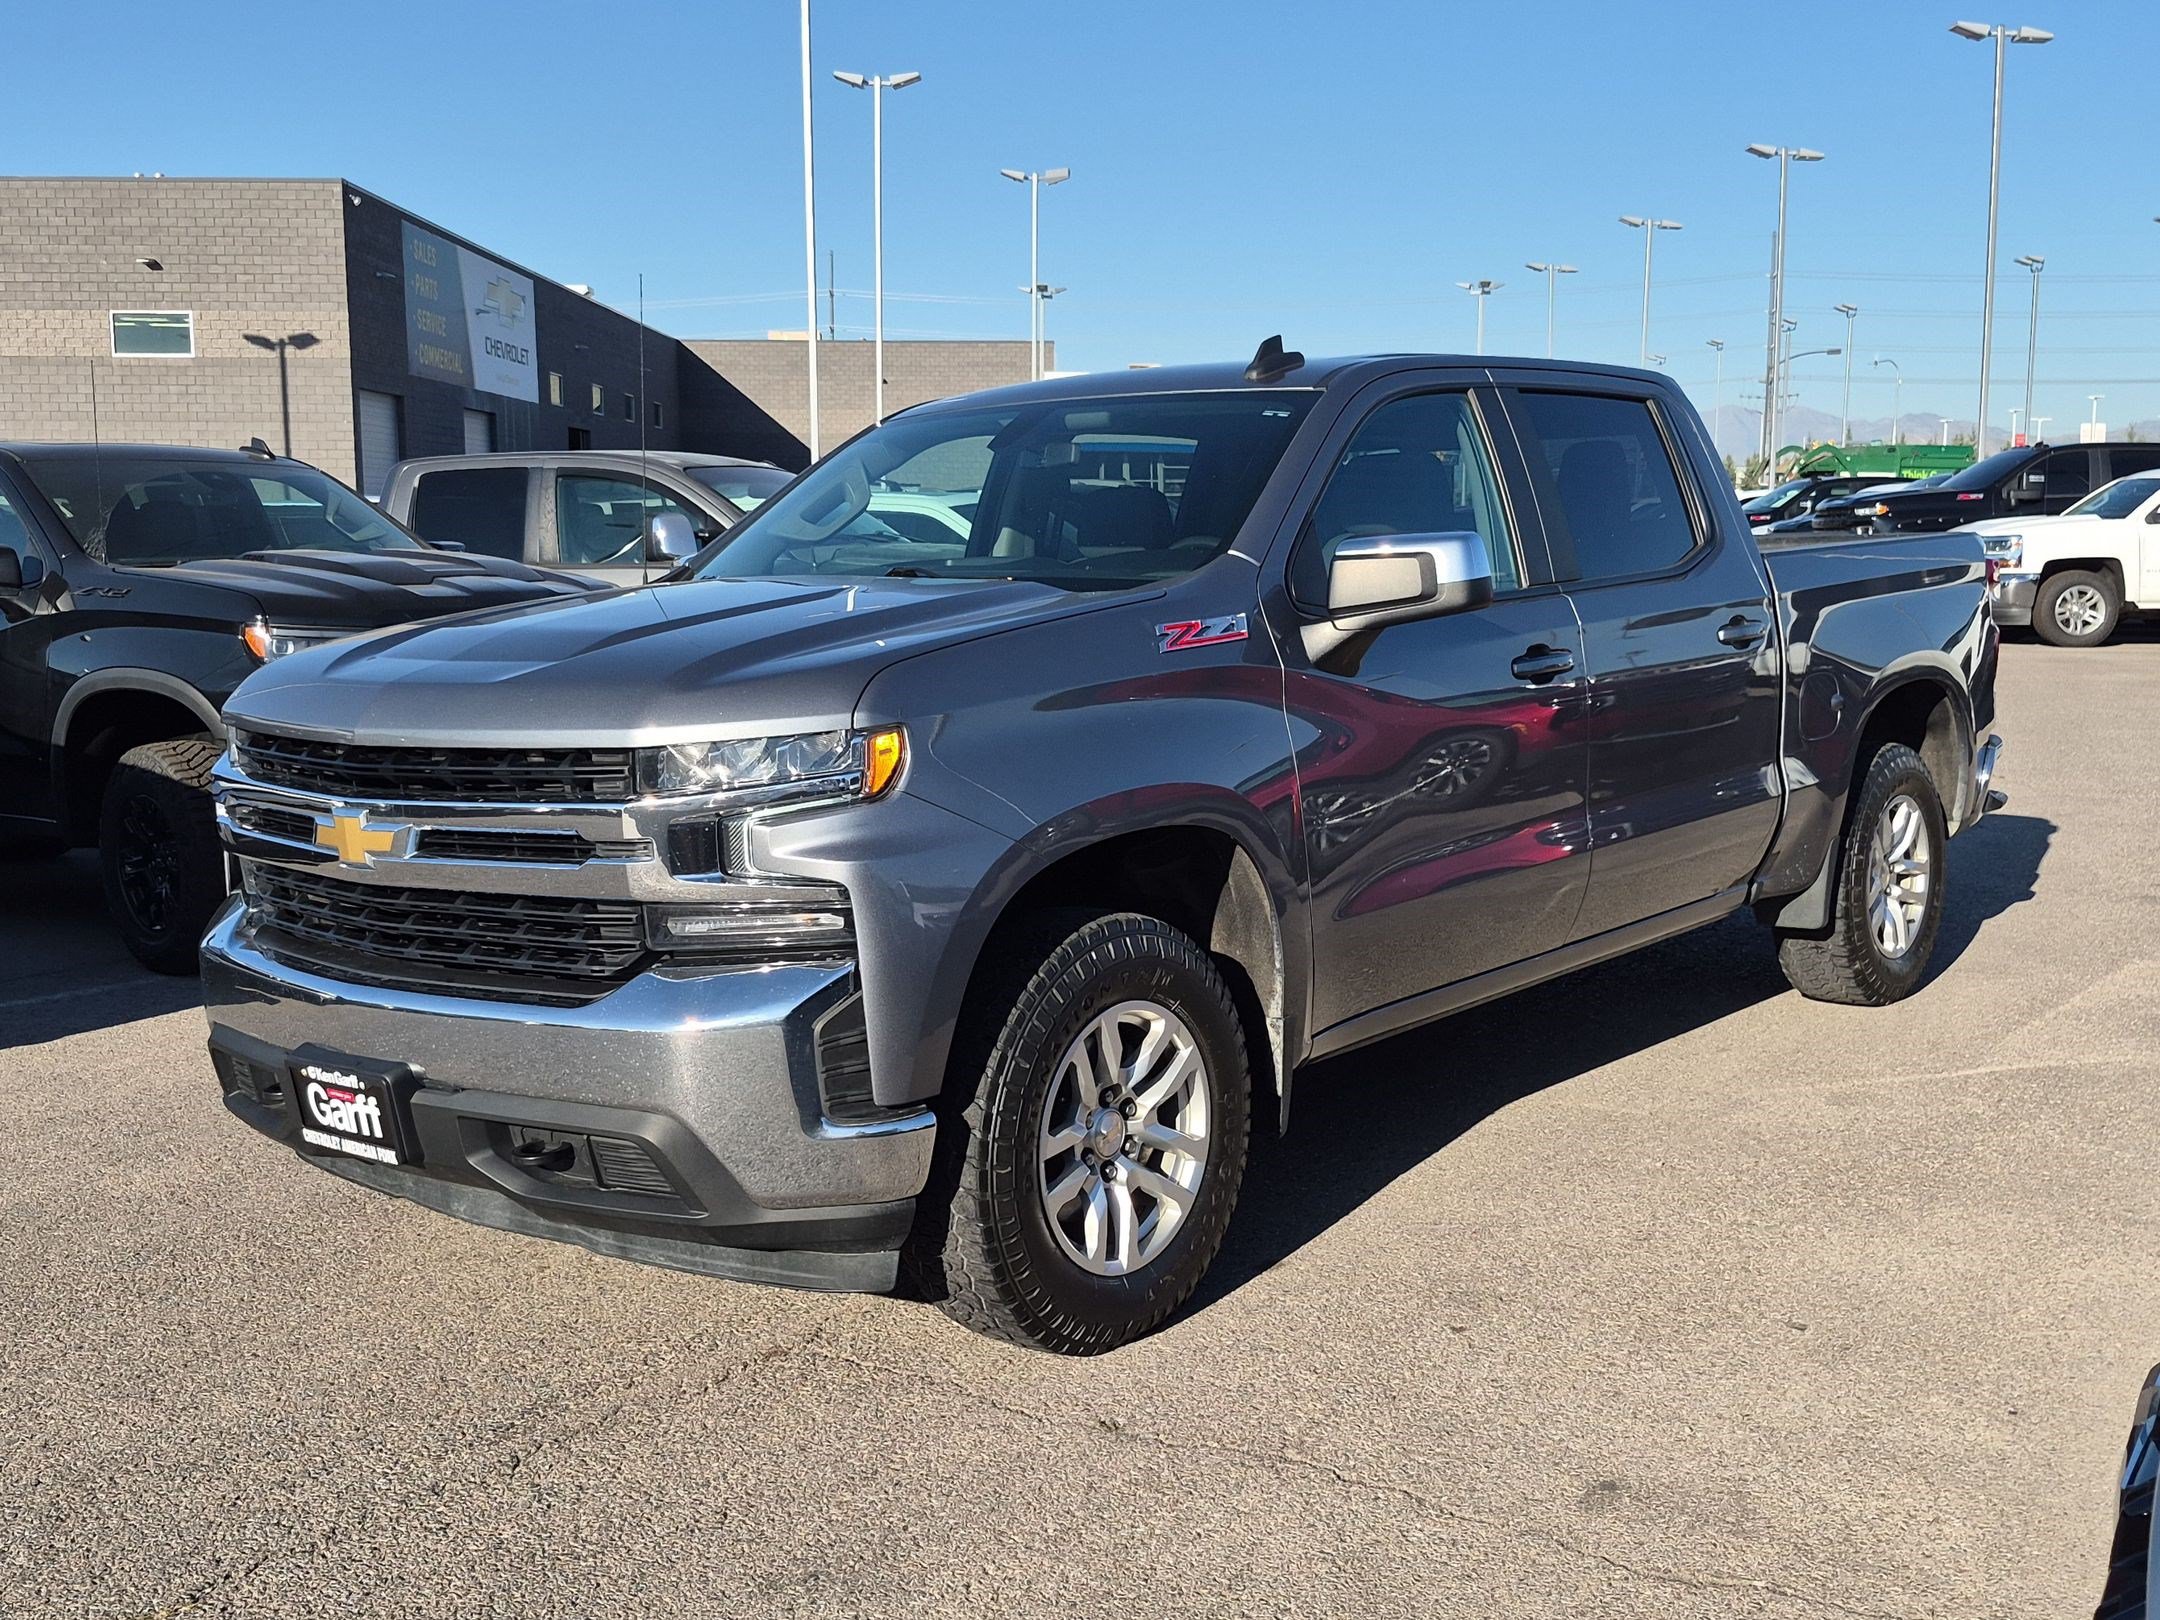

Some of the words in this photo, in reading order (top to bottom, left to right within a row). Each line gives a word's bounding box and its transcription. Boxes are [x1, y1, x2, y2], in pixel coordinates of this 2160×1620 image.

[413, 240, 437, 267] SALES
[415, 274, 438, 300] PARTS
[416, 308, 447, 337] SERVICE
[419, 343, 464, 374] COMMERCIAL
[484, 336, 529, 366] CHEVROLET
[1902, 469, 1929, 480] Think
[1155, 613, 1249, 654] Z71
[307, 1082, 384, 1139] Garff
